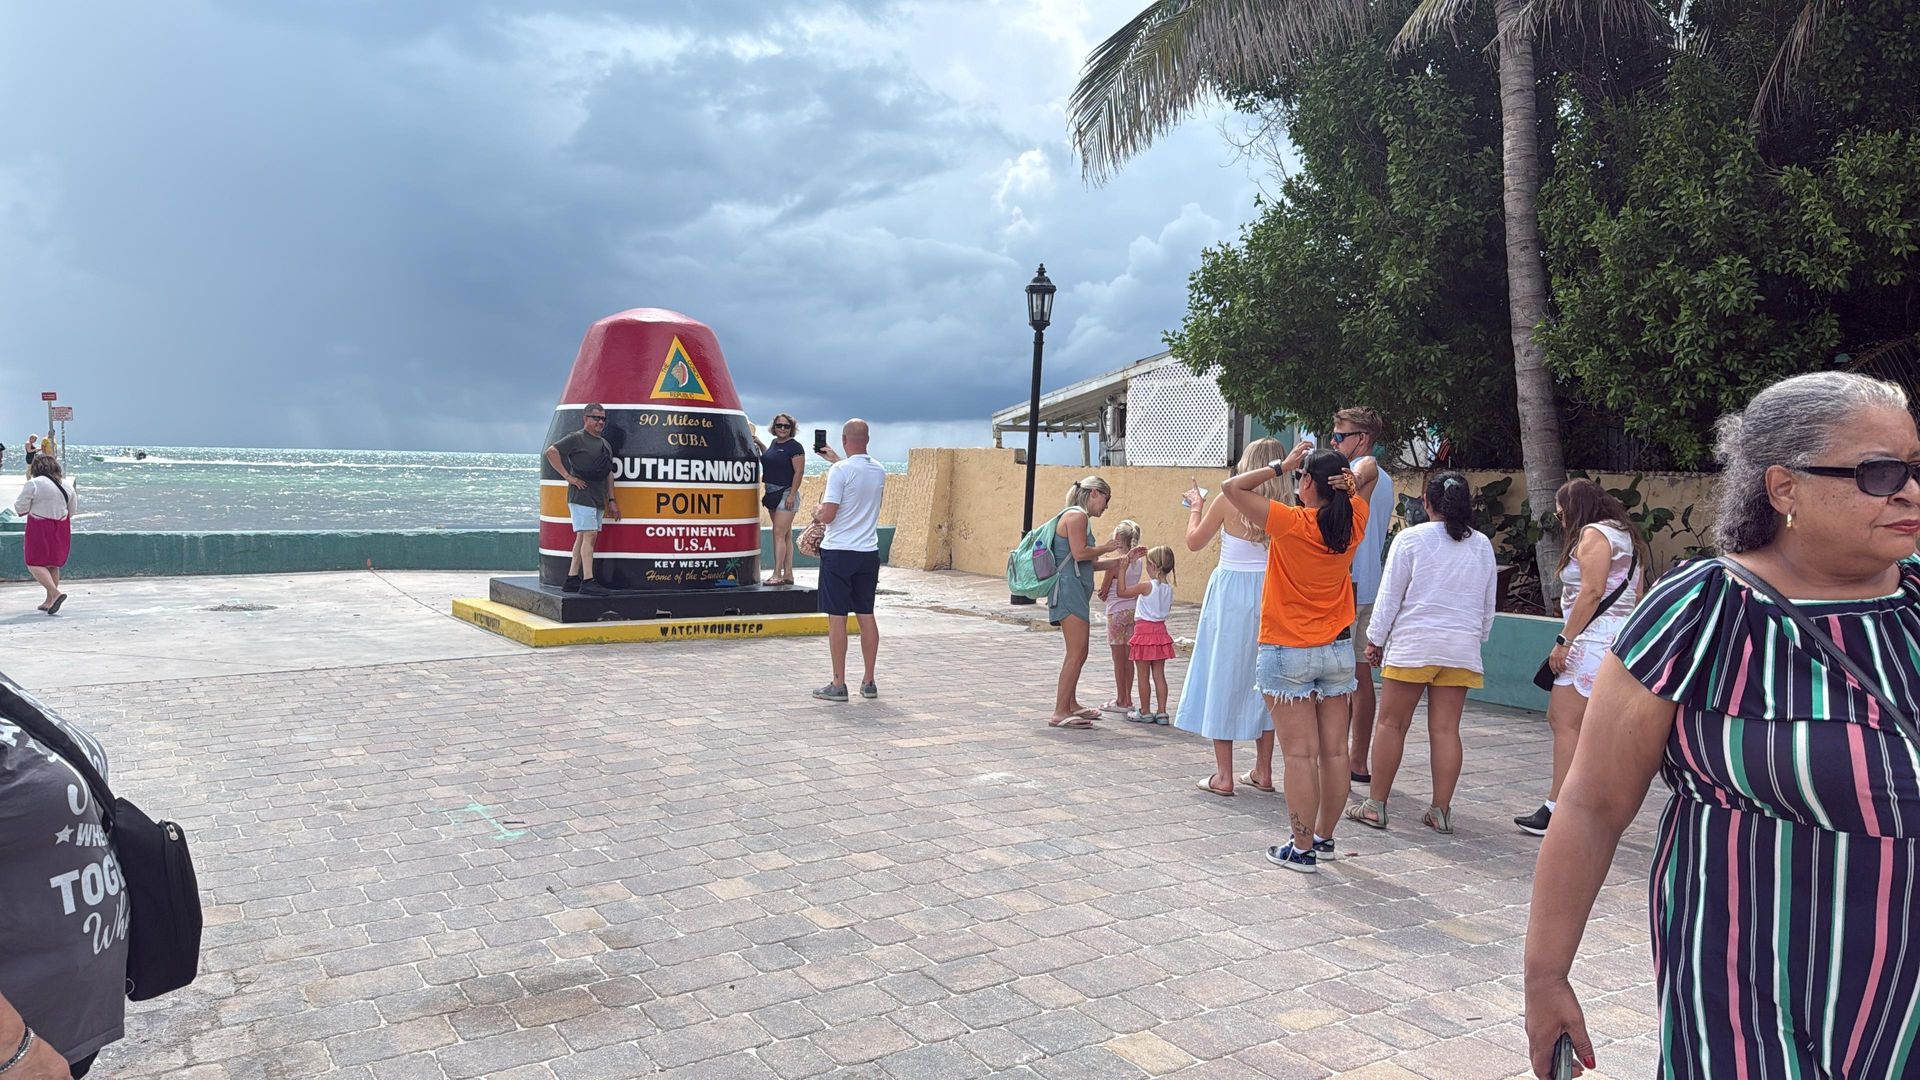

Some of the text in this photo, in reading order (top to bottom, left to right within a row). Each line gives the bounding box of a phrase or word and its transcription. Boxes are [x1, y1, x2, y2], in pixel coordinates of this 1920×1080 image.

[639, 413, 714, 428] 90 Miles to
[667, 433, 708, 448] CUBA
[612, 457, 756, 482] OUTHERNMOST
[656, 493, 724, 515] POINT
[645, 526, 736, 537] CONTINENTAL
[673, 538, 717, 552] U.S.A.
[654, 561, 676, 569] KEY
[645, 569, 726, 584] Home of the Sunset
[660, 623, 764, 637] WATCH YOUR STEP
